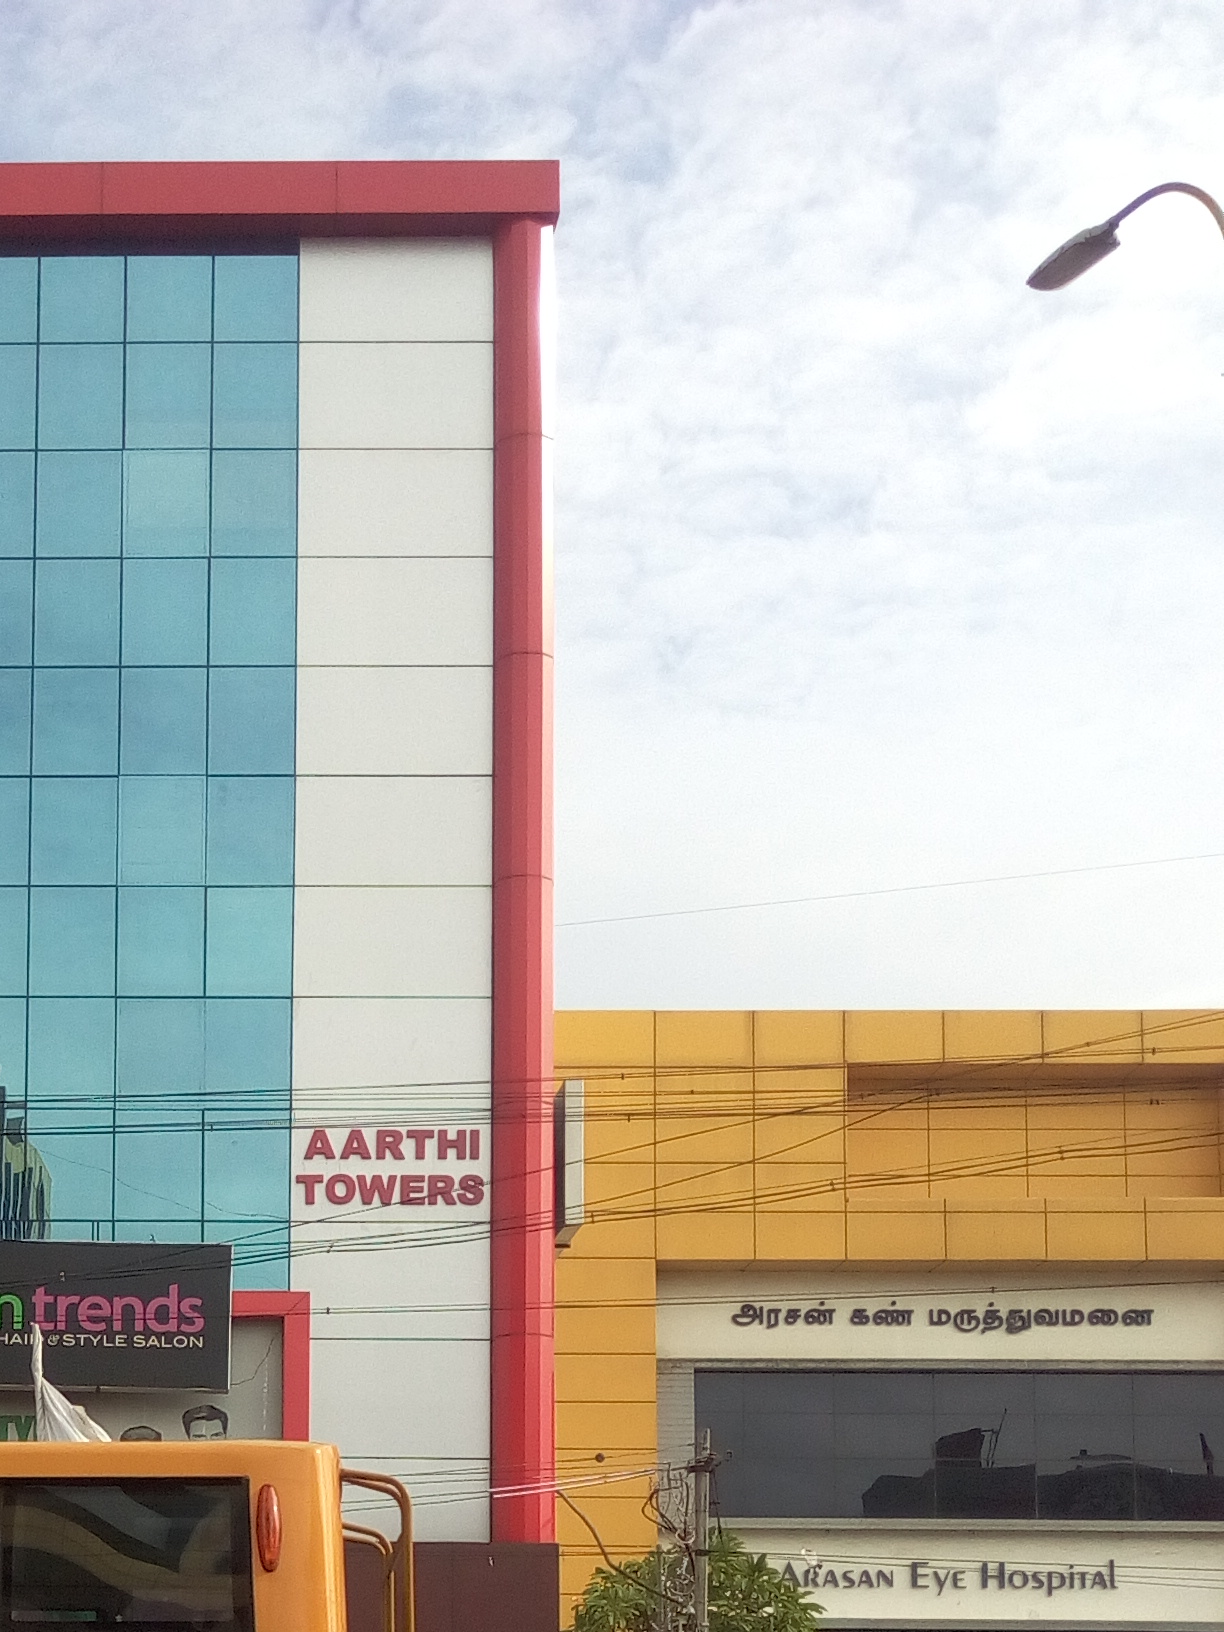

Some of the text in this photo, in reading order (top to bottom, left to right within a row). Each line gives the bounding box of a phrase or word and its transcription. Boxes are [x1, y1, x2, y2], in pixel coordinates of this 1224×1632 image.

[304, 1129, 480, 1160] AARTHI
[295, 1173, 484, 1206] TOWERS
[31, 1283, 204, 1333] trends
[731, 1300, 1155, 1335] அரசன் கண் மருத்துவமனை
[47, 1333, 61, 1346] &
[62, 1334, 128, 1347] STYLE
[133, 1335, 203, 1348] SALON
